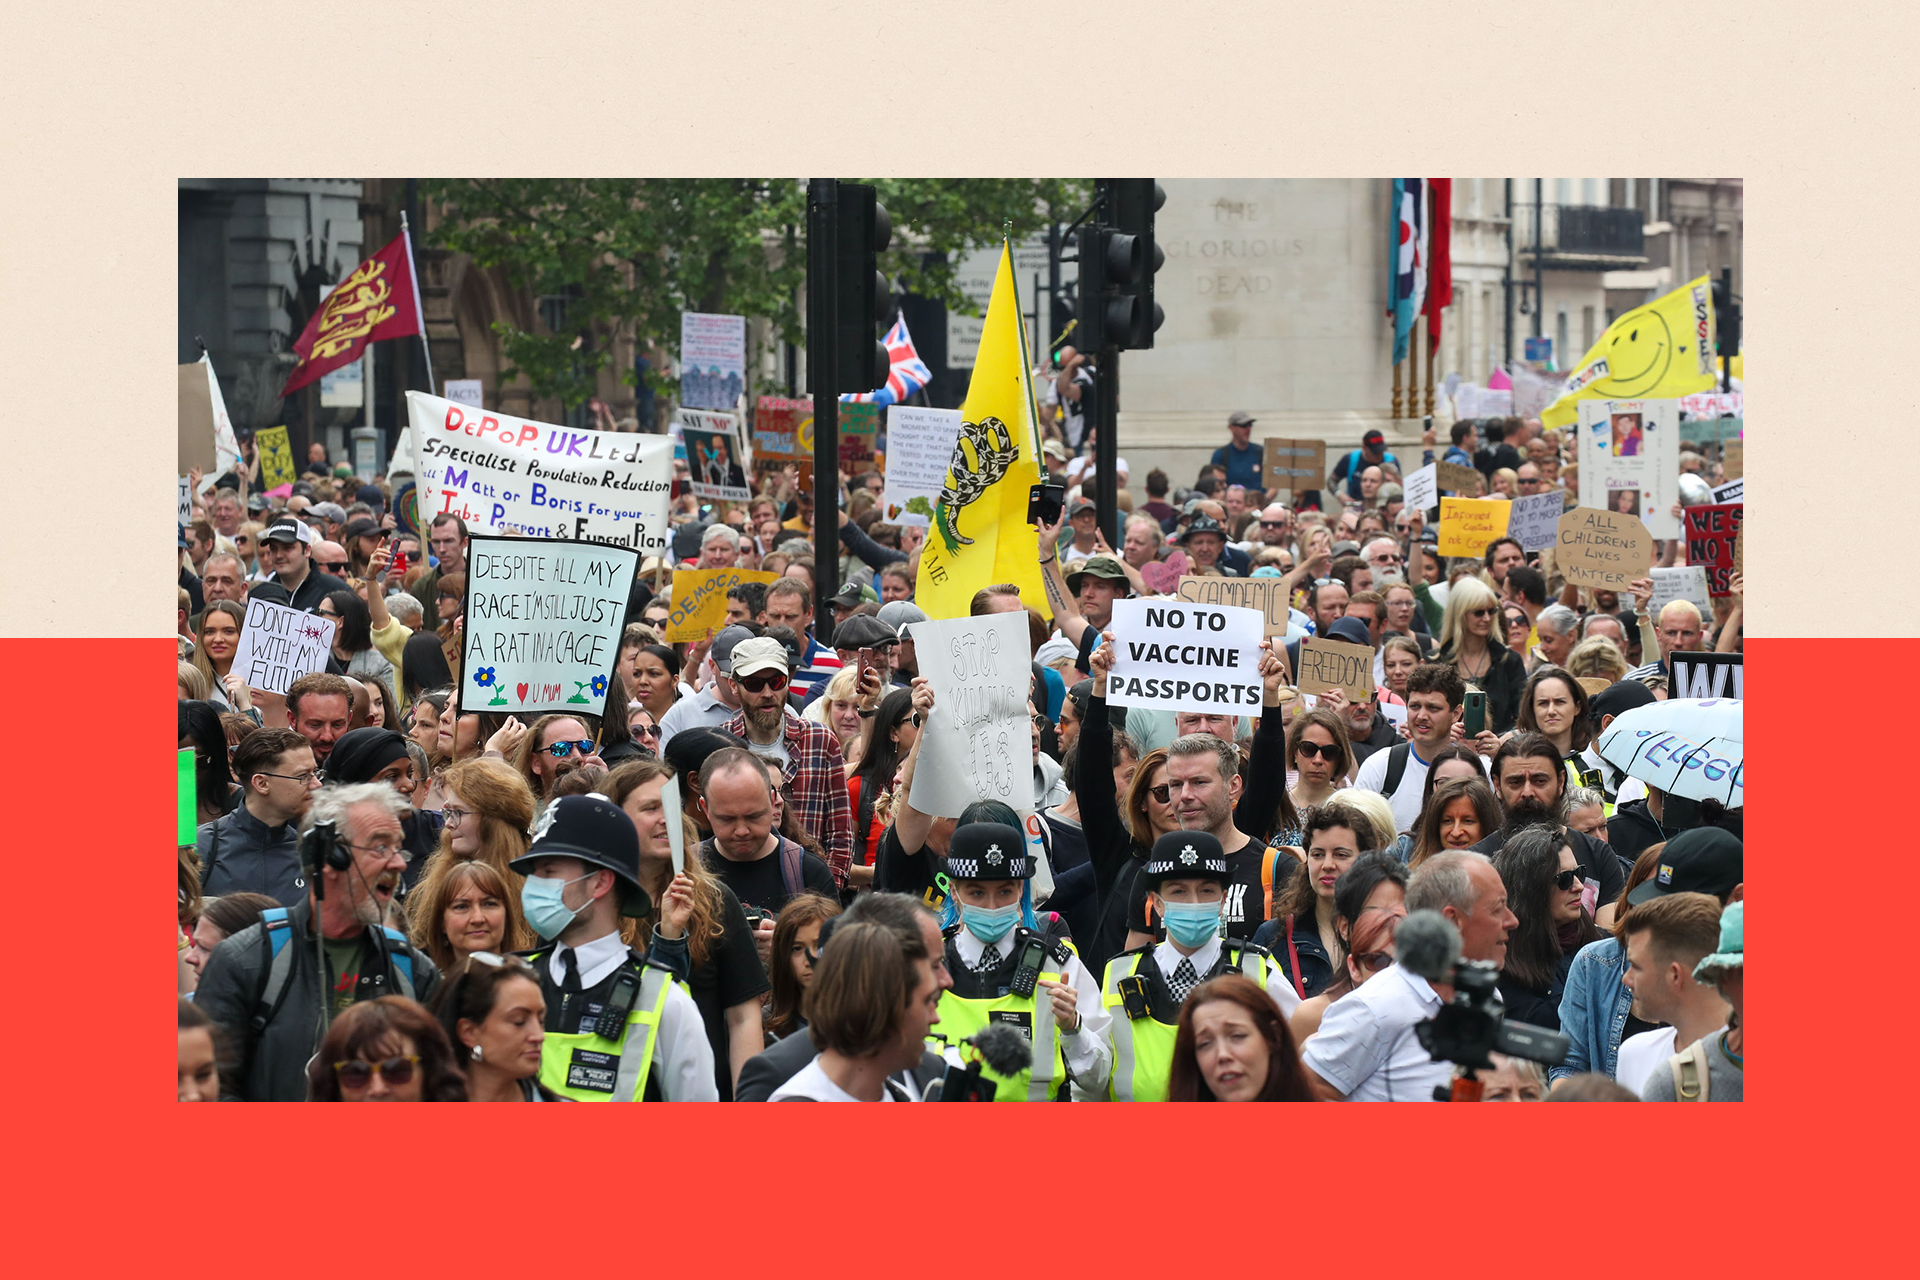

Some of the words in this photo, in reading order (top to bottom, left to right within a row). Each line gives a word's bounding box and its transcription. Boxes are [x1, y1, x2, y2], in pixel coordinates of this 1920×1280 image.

[1209, 201, 1258, 221] THE
[1166, 238, 1304, 259] GLORIOUS
[1197, 274, 1272, 294] DEAD
[891, 431, 920, 440] THOUGHT
[901, 423, 930, 431] MOMENT
[899, 450, 921, 459] TESTED
[890, 468, 908, 477] OVER
[908, 470, 920, 478] THE
[502, 490, 521, 503] or
[530, 482, 583, 512] Boris
[612, 510, 643, 521] your
[1583, 513, 1618, 530] ALL
[1690, 511, 1725, 532] WE
[633, 522, 667, 549] Plan
[1561, 530, 1637, 549] CHILDRENS
[1584, 547, 1621, 561] LIVES
[475, 553, 546, 582] DESPITE
[553, 557, 577, 585] ALL
[583, 560, 623, 589] MY
[1568, 565, 1626, 584] MATTER
[473, 592, 520, 620] RAGE
[570, 595, 624, 627] JUST
[1146, 608, 1186, 629] NO
[1193, 611, 1226, 632] TO
[251, 631, 293, 665] WITH
[294, 644, 321, 672] MY
[467, 632, 486, 661] A
[493, 632, 530, 664] RAT
[555, 630, 608, 668] CAGE
[950, 628, 1001, 682] STOP
[1128, 641, 1240, 668] VACCINE
[1300, 648, 1368, 689] FREEDOM
[531, 682, 540, 703] U
[541, 682, 562, 704] MUM
[1110, 675, 1261, 705] PASSPORTS
[969, 730, 1015, 802] US
[568, 1078, 589, 1087] POLICE
[589, 1080, 613, 1089] OFFICER
